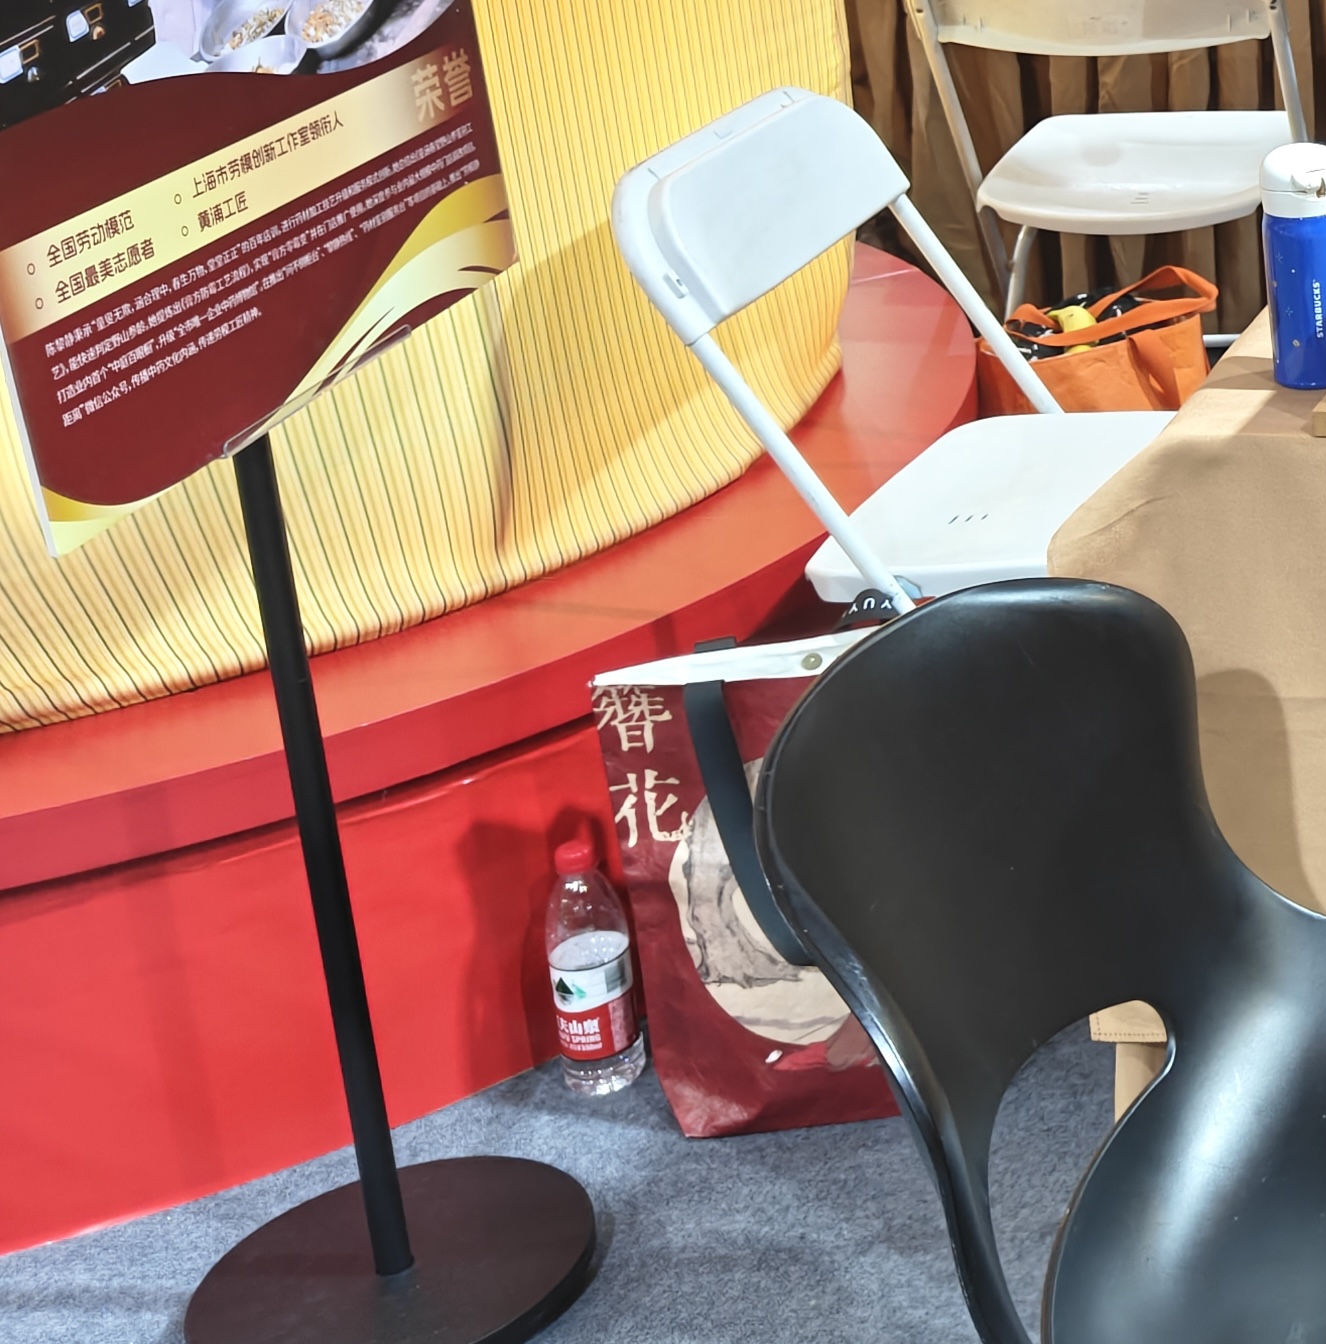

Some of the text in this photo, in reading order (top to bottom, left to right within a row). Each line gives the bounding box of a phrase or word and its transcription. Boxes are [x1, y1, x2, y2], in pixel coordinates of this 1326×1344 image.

[410, 49, 474, 123] 荣誉
[191, 110, 345, 200] 上海市劳模创新工作室领衔人
[46, 208, 135, 269] 全国劳动模范
[197, 191, 249, 234] 黄浦工匠
[53, 237, 156, 305] 全国最美志愿者
[1312, 279, 1325, 338] STARBUCKS
[556, 1015, 601, 1035] 夫山泉
